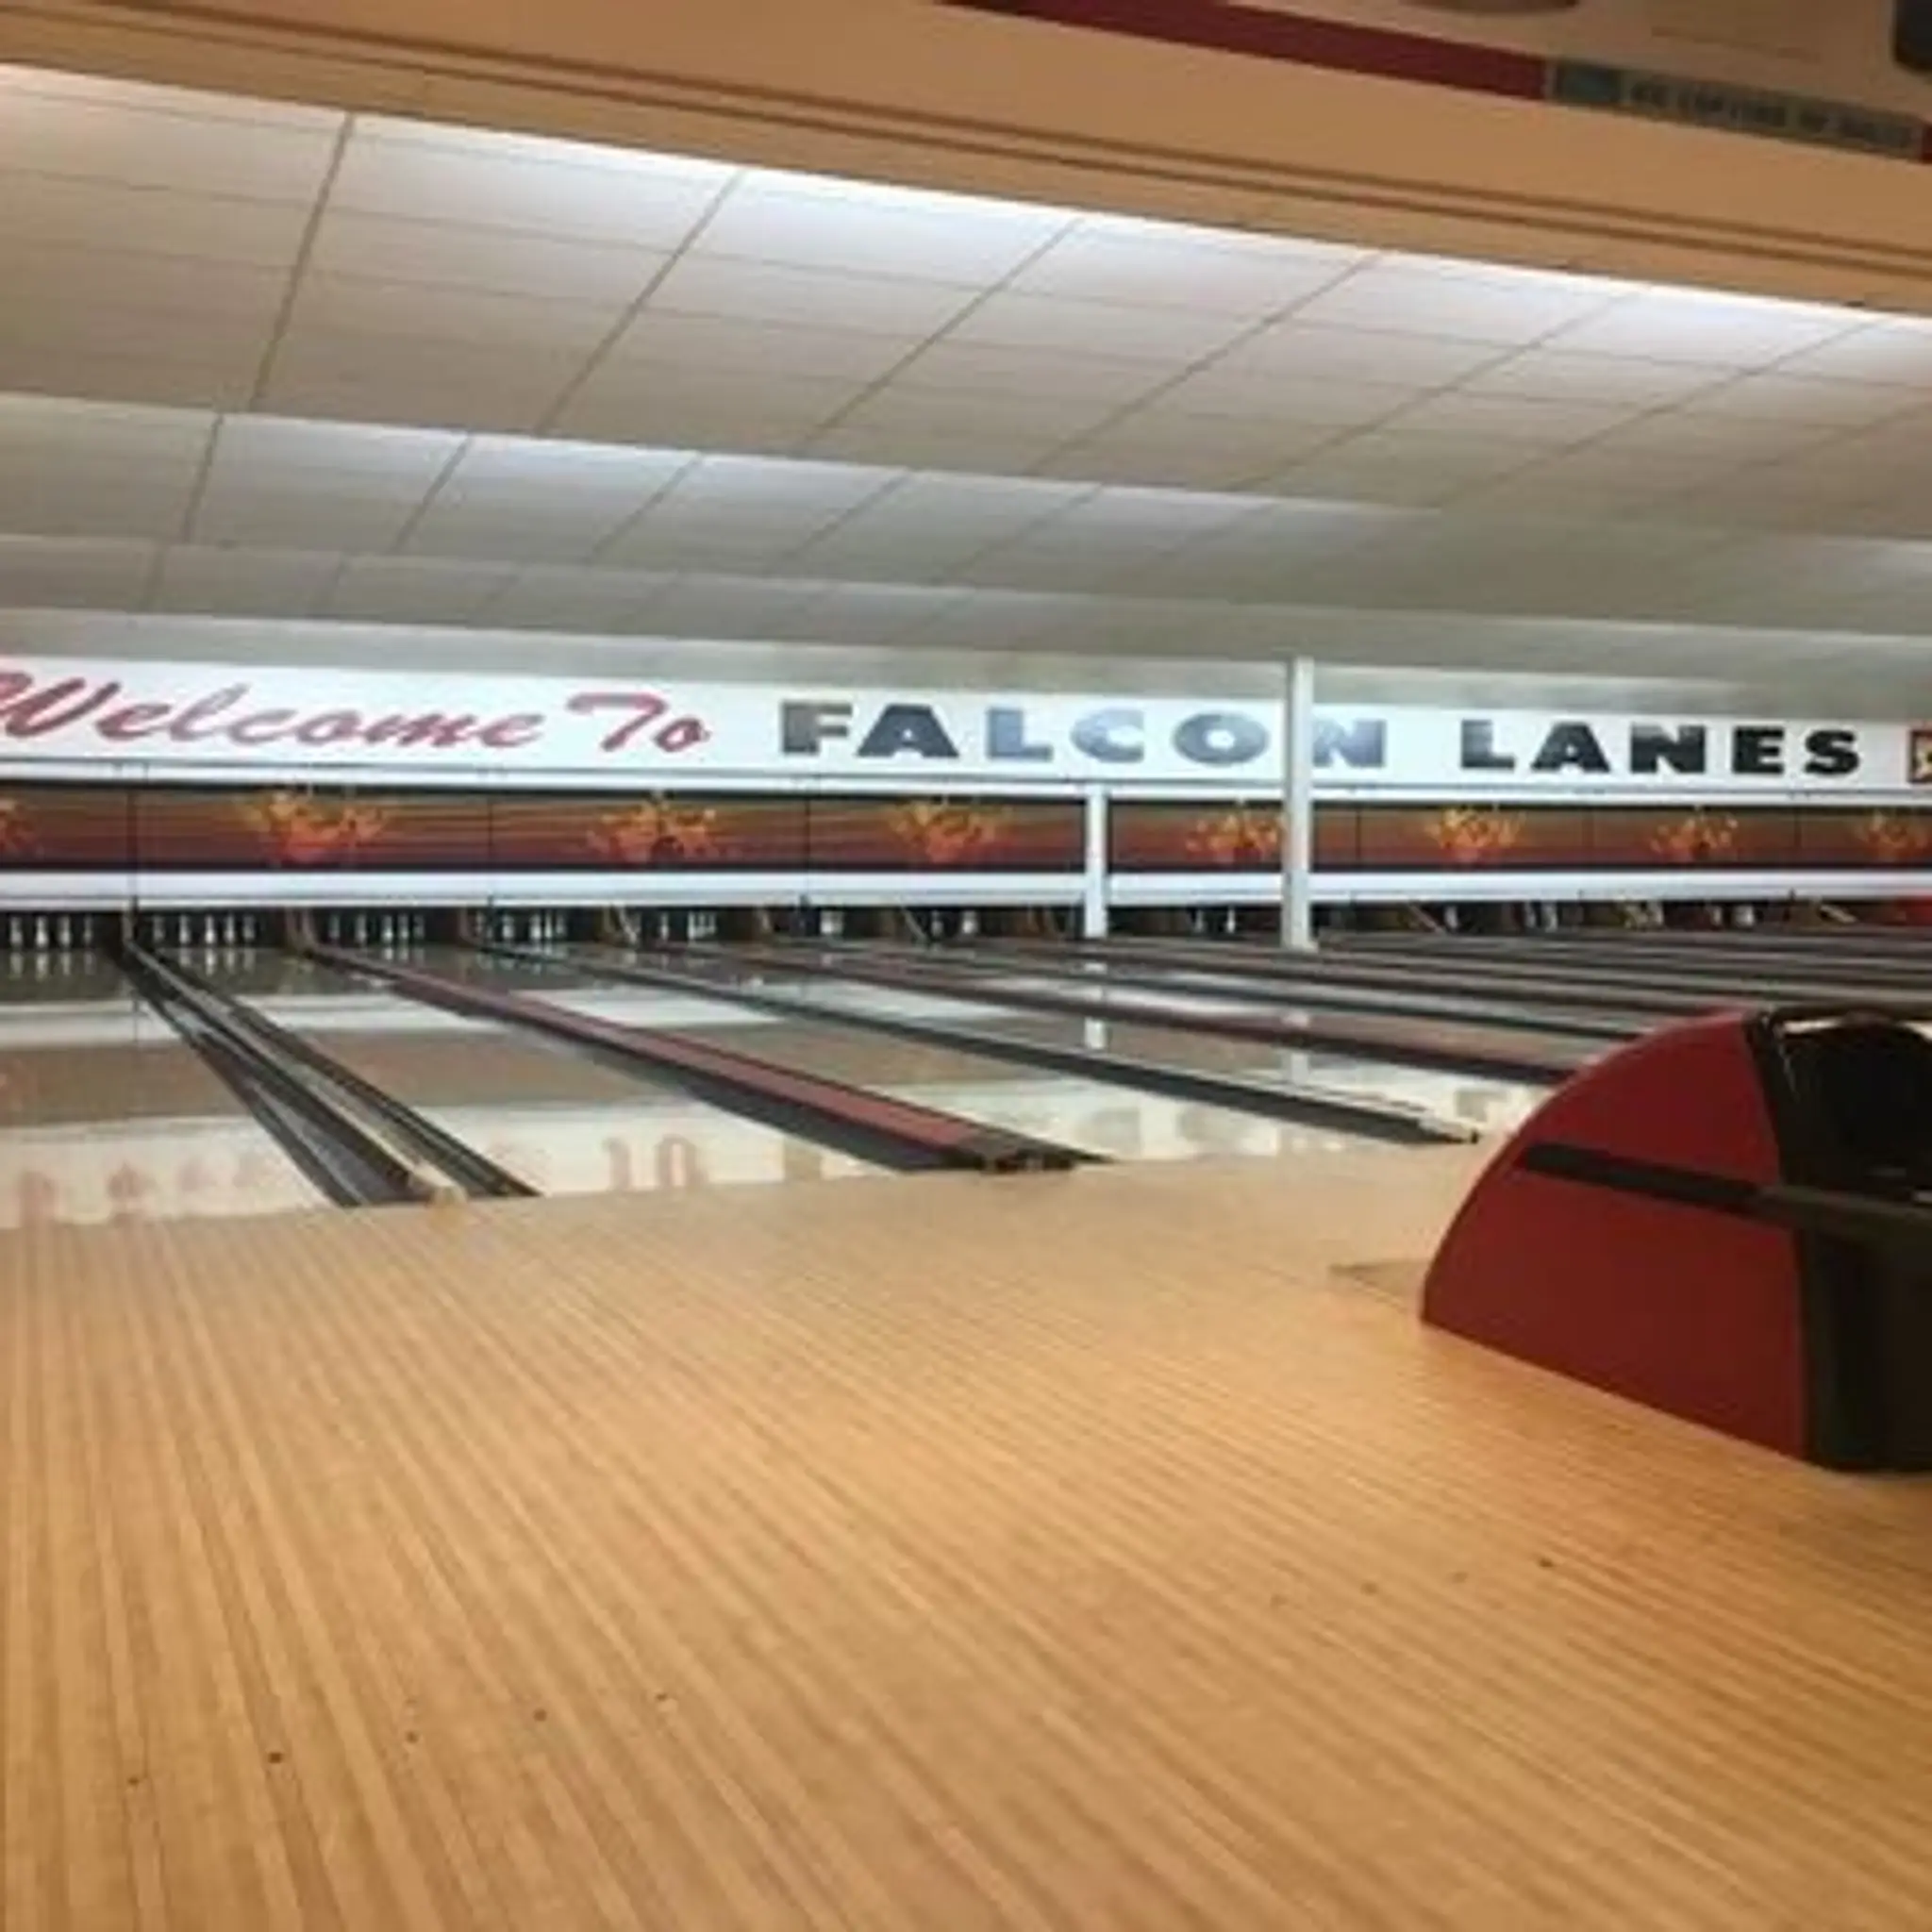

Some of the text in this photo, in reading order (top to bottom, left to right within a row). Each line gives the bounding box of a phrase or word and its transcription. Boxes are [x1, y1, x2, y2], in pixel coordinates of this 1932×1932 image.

[0, 671, 1860, 776] Welcome To FALCON LANES
